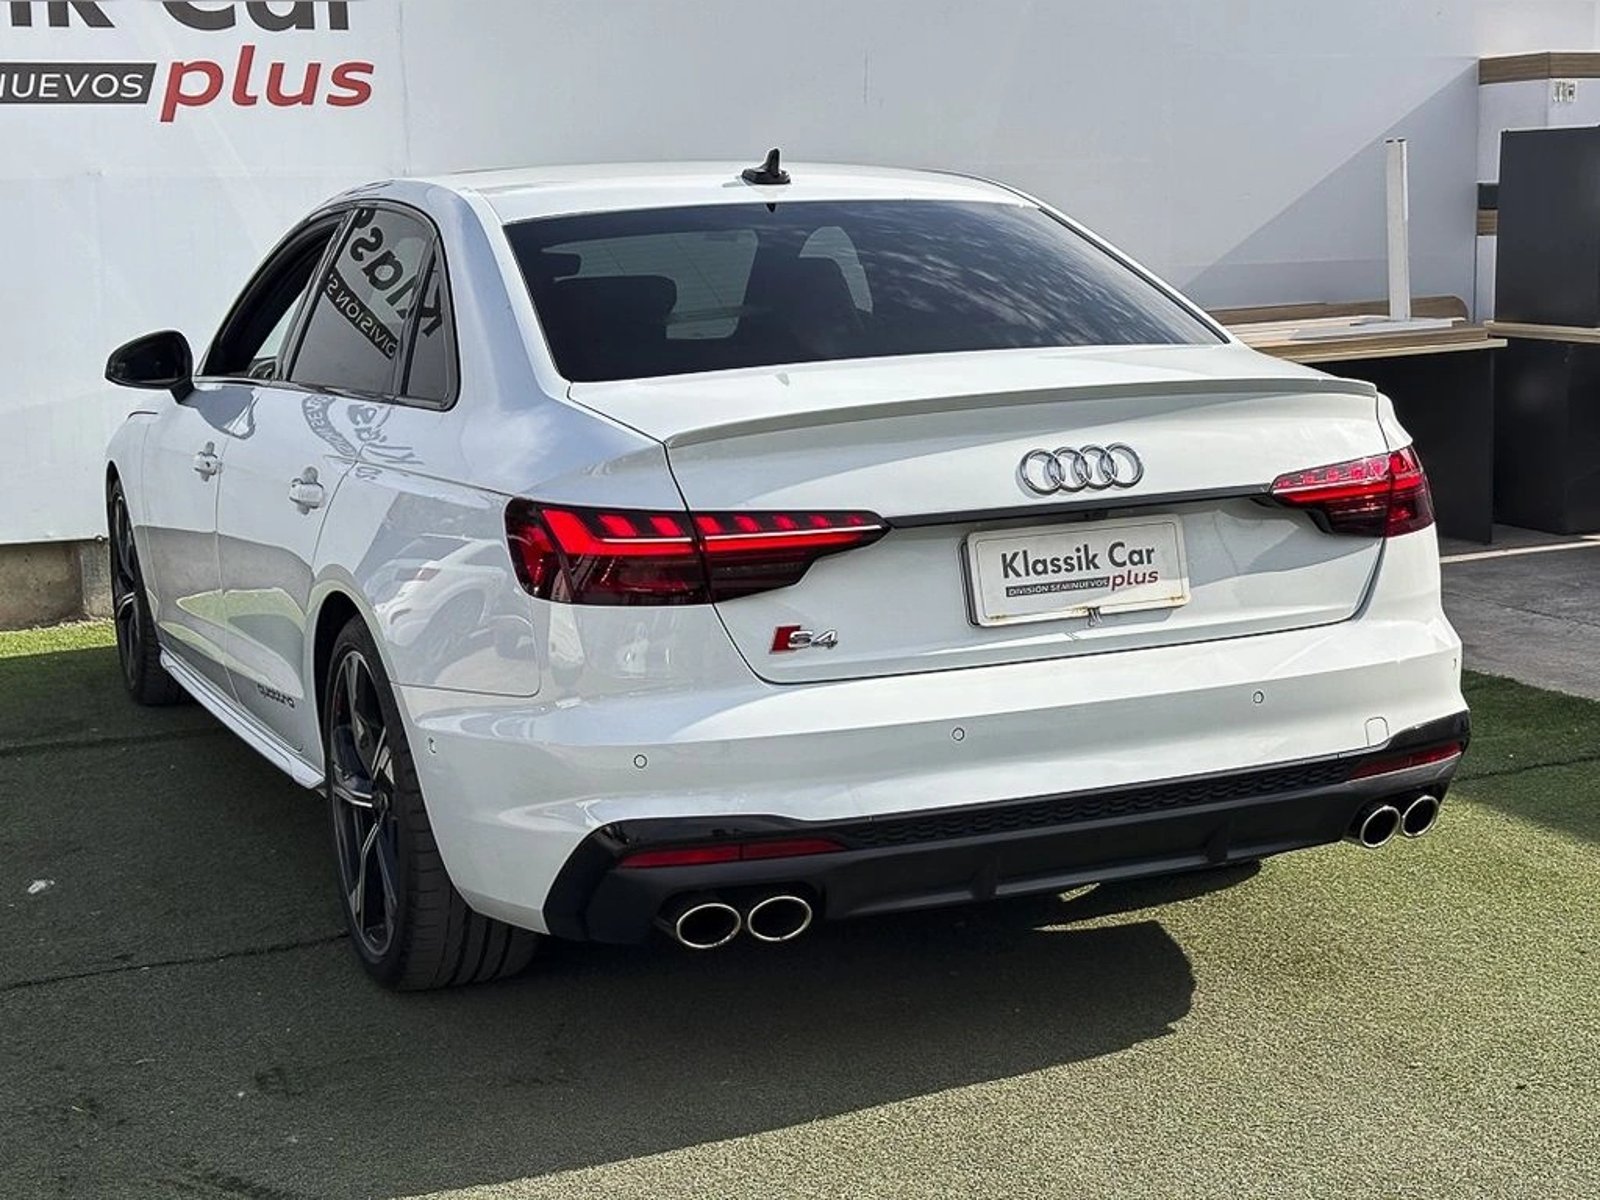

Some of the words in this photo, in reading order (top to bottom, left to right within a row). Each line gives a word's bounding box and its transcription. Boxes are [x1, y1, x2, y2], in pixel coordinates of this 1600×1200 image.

[0, 73, 144, 98] UEVOS
[160, 44, 375, 122] plus
[1001, 544, 1100, 578] Klassik
[1107, 541, 1155, 568] Car
[1111, 569, 1159, 592] plus
[785, 629, 839, 650] S4
